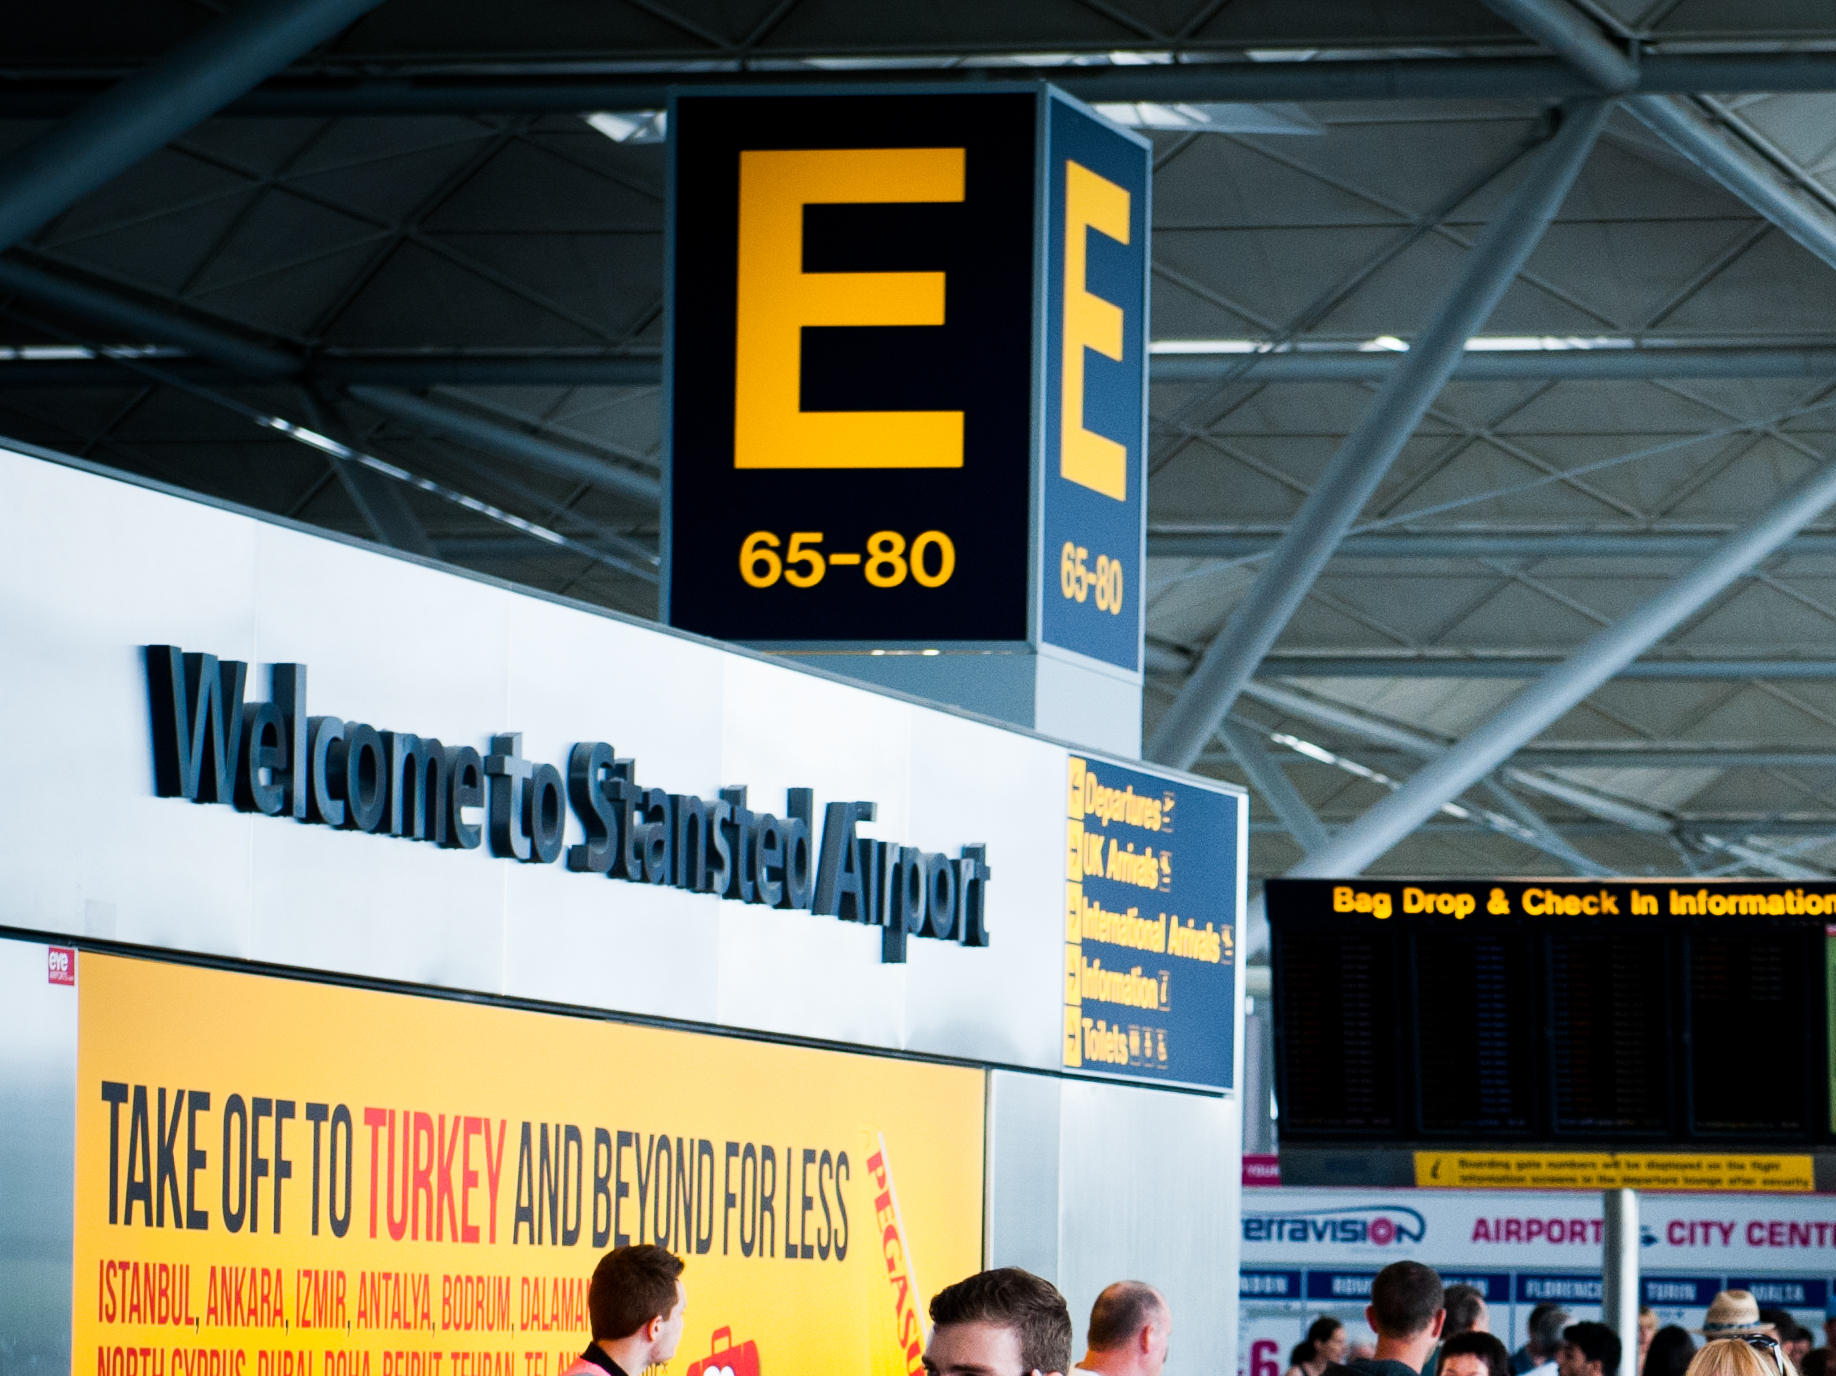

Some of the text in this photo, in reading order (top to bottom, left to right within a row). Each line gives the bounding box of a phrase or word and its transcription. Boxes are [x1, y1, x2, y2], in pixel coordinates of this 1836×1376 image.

[734, 147, 966, 469] E
[1060, 158, 1131, 502] E
[739, 530, 955, 588] 65-80
[1060, 541, 1123, 615] 65-80
[146, 644, 991, 964] Welcome to Stansted Airport
[1085, 772, 1162, 832] Departures
[1083, 832, 1159, 890] UK Arrivals
[1081, 896, 1221, 963] International Arrivals
[1332, 886, 1393, 919] Bag
[1402, 888, 1476, 919] Drop
[1486, 888, 1511, 915] &
[1521, 888, 1620, 916] Check
[1630, 889, 1659, 915] In
[1081, 956, 1159, 1010] Information
[1081, 1017, 1129, 1065] Toilets
[101, 1081, 850, 1262] TAKE OFF TO TURKEY AND BEYOND FOR LESS
[1471, 1218, 1604, 1245] AIRPORT
[1666, 1219, 1736, 1247] CITY
[98, 1259, 200, 1334] ISTANBUL,
[205, 1265, 290, 1335] ANKARA,
[295, 1269, 351, 1337] IZMIR,
[357, 1271, 436, 1337] ANTALYA,
[441, 1275, 516, 1338] BODRUM,
[1646, 1282, 1697, 1302] TURIN
